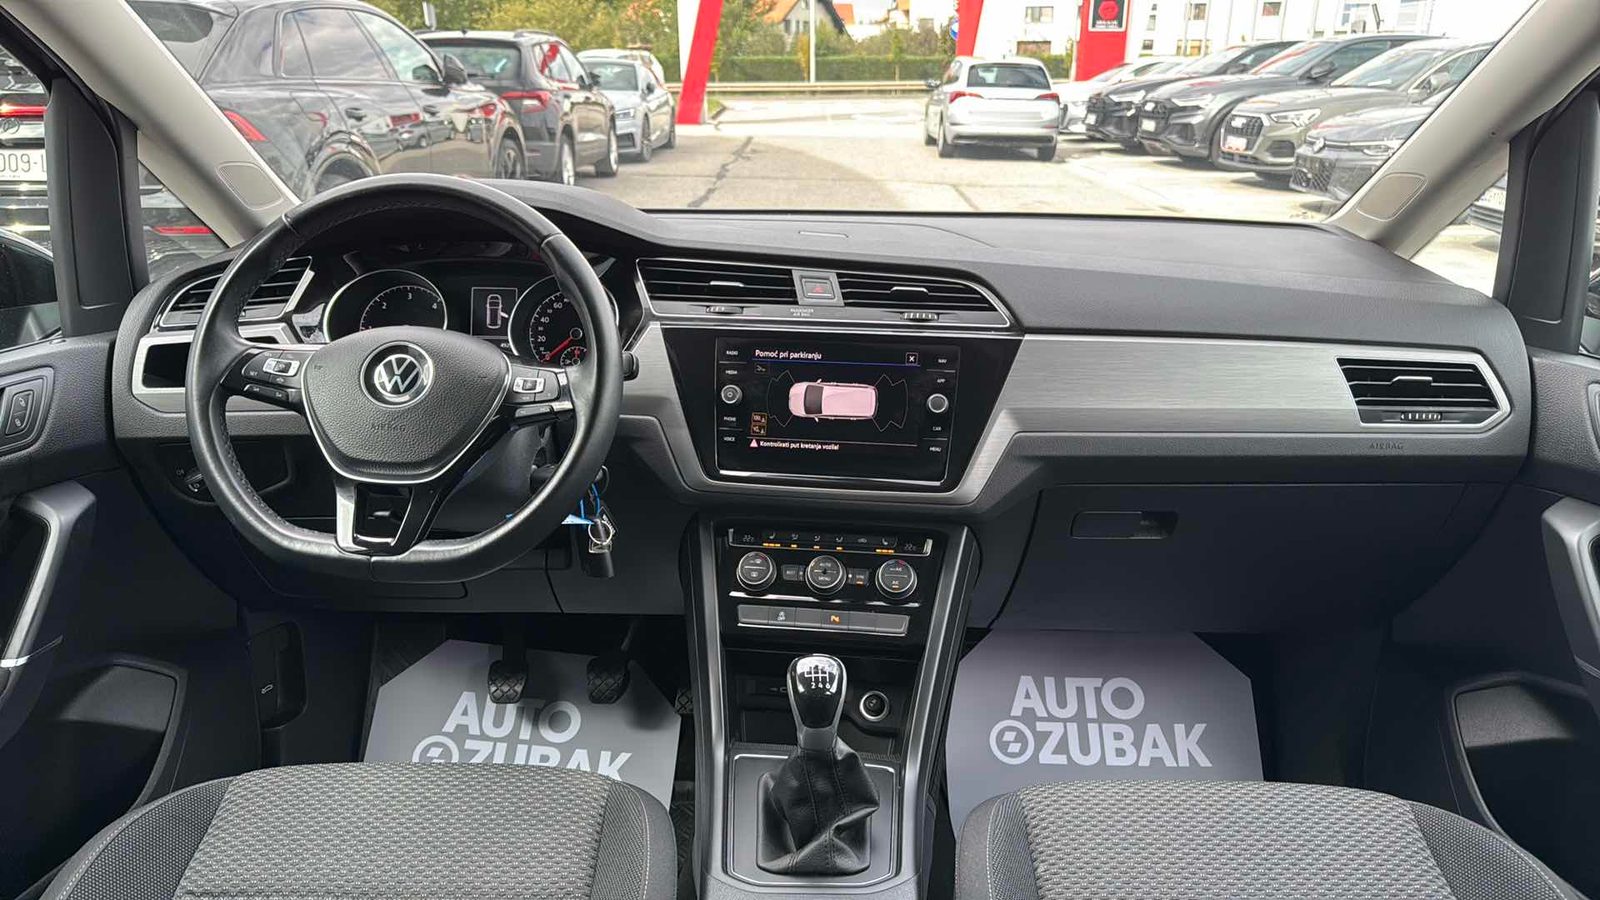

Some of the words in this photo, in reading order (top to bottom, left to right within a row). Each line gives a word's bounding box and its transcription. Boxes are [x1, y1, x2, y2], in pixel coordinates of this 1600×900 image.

[407, 292, 413, 300] 3
[381, 302, 388, 310] 2
[431, 302, 438, 310] 4
[755, 349, 779, 358] Pomoć
[779, 351, 789, 359] pri
[789, 352, 822, 360] parkiranju
[1010, 675, 1145, 720] AUTO
[441, 691, 582, 743] AUTO
[1035, 721, 1213, 767] ZUBAK
